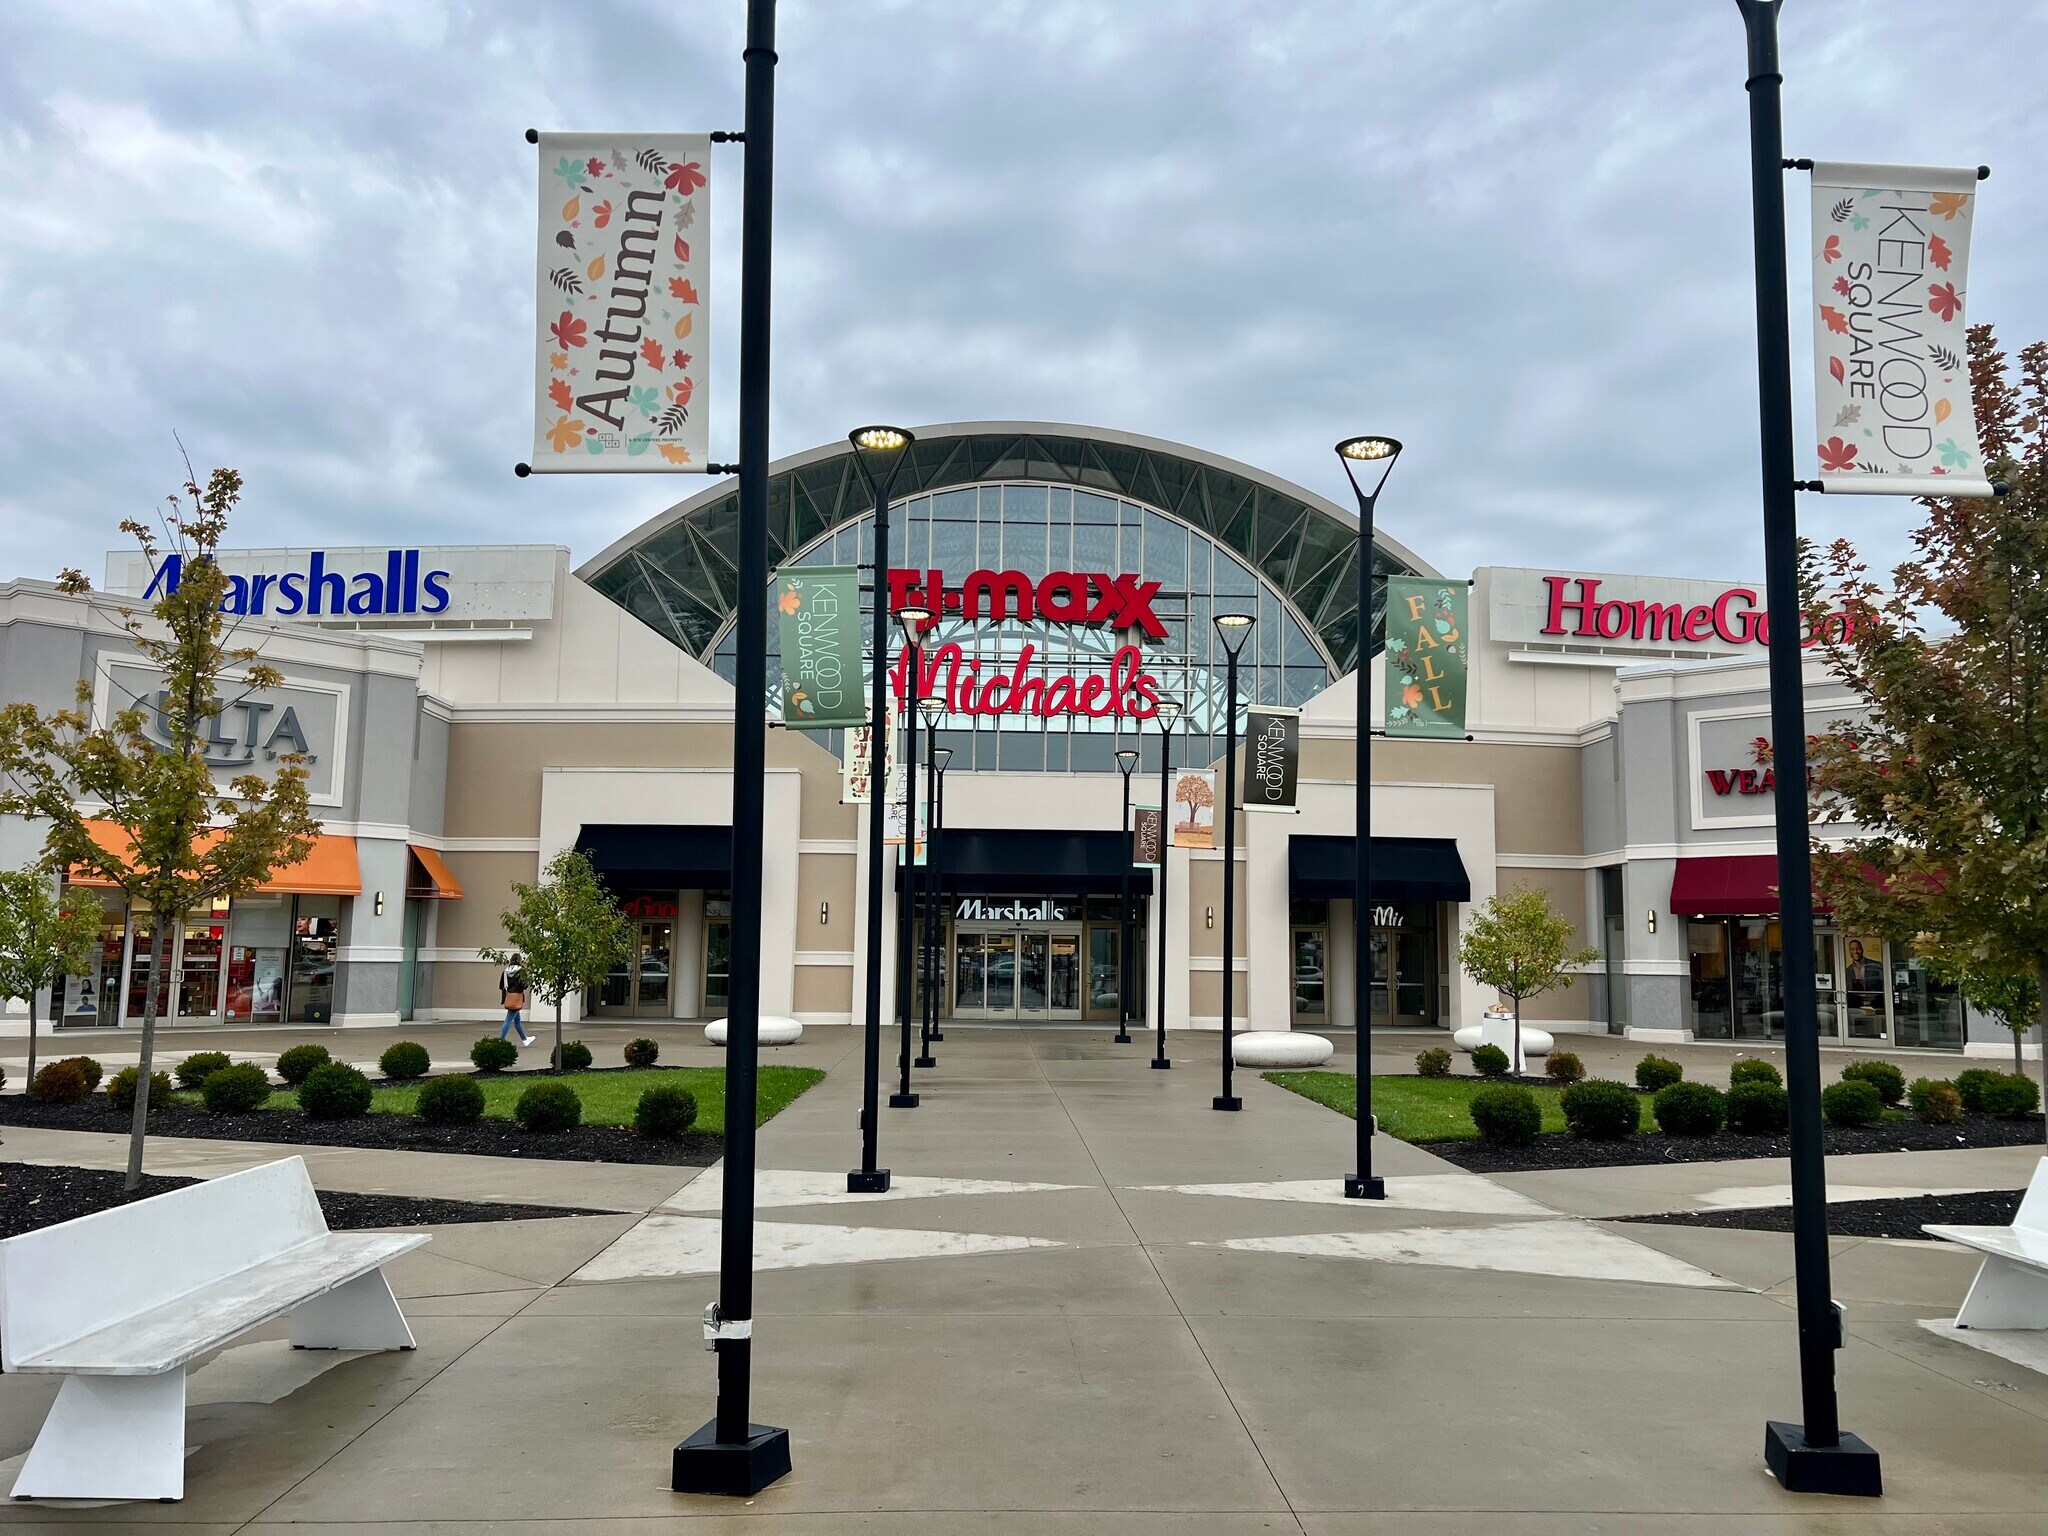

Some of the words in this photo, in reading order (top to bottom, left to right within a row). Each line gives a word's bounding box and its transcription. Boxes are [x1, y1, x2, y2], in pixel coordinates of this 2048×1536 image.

[576, 190, 667, 432] Autumn
[1847, 260, 1876, 400] SQUARE
[1877, 205, 1933, 460] KENWOOD
[797, 611, 815, 680] SQUARE
[811, 583, 843, 709] KENWOOD
[888, 641, 1160, 719] Michaels
[1405, 594, 1452, 712] FALL
[202, 744, 318, 764] BEAUY
[1256, 734, 1268, 780] SQUARE
[1266, 717, 1286, 801] KENWOOD
[1140, 821, 1148, 849] SQUARE
[1146, 811, 1158, 862] KENWOOD
[956, 899, 1064, 920] Marshalls
